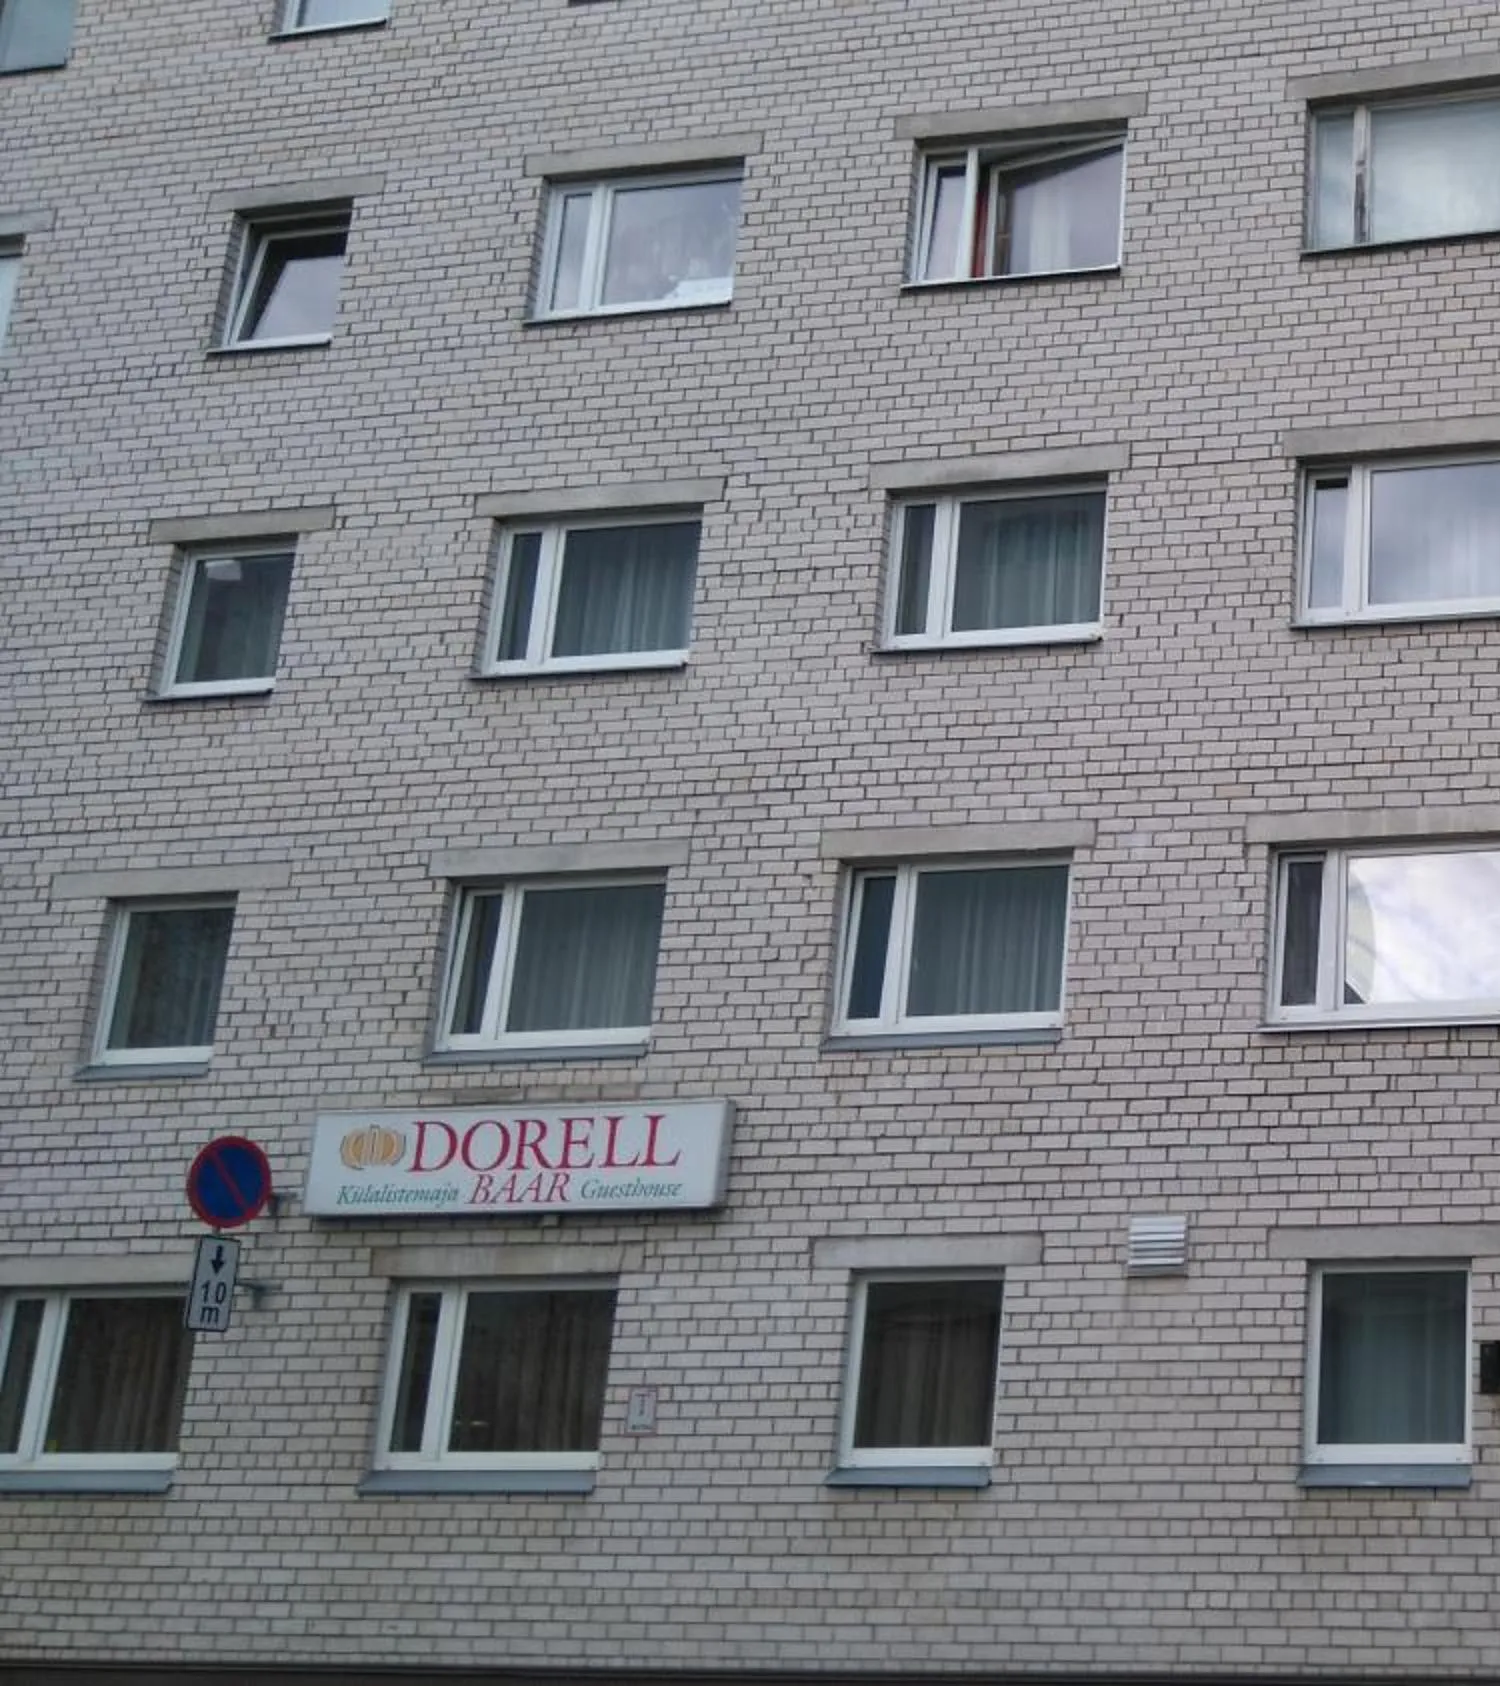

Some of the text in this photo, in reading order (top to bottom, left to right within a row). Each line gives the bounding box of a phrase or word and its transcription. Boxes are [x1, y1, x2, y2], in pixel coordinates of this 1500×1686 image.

[409, 1114, 682, 1173] DORELL
[464, 1172, 572, 1206] BAAR
[580, 1176, 683, 1200] Guesthouse
[201, 1280, 227, 1304] 10
[200, 1305, 220, 1324] m
